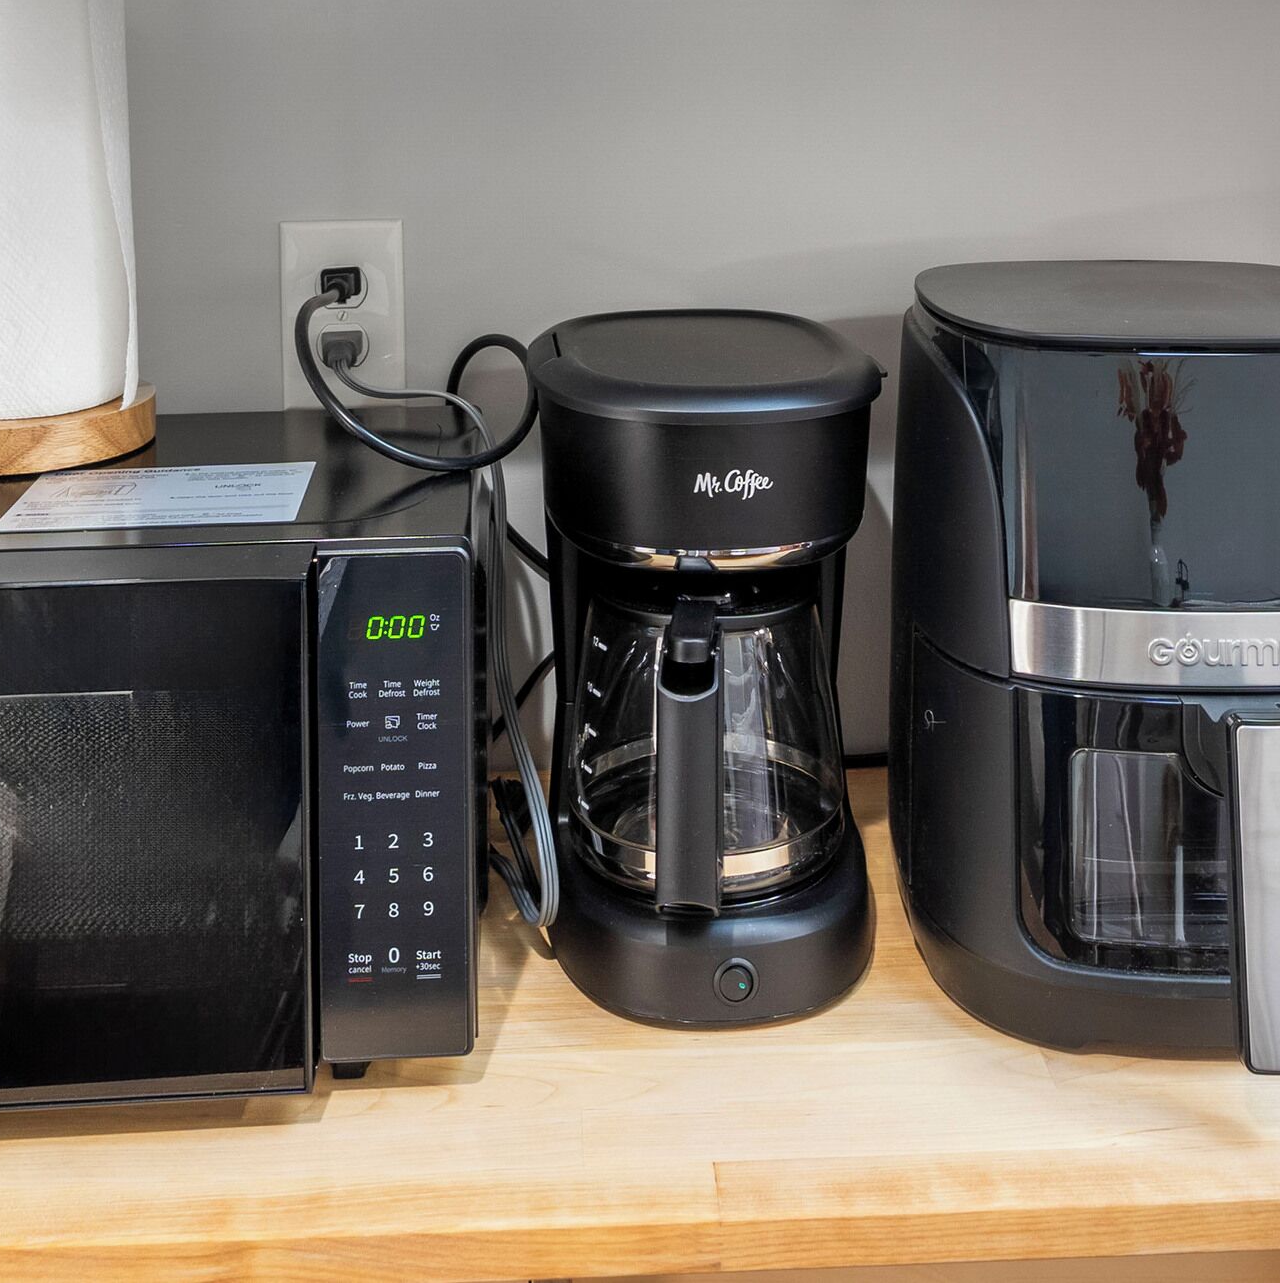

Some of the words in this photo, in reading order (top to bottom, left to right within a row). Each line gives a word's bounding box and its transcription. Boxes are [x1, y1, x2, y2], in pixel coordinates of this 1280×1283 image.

[693, 472, 722, 498] Mr.
[724, 469, 774, 500] Coffee
[429, 613, 440, 622] Oz
[365, 614, 426, 640] 0:00
[349, 681, 368, 690] Time
[383, 680, 402, 689] Time
[413, 679, 440, 689] Weight
[348, 690, 367, 699] Cook
[378, 689, 406, 698] Defrost
[413, 687, 441, 697] Defrost
[416, 712, 438, 721] Timer
[346, 719, 370, 729] Power
[417, 721, 437, 730] Clock
[378, 735, 408, 743] UNLOCK
[343, 764, 374, 774] Popcorn
[380, 762, 405, 771] Potato
[418, 761, 437, 771] Pizza
[343, 792, 357, 800] Frz.
[358, 791, 374, 801] Veg.
[375, 791, 410, 801] Beverage
[415, 789, 440, 799] Dinner
[354, 835, 364, 850] 1
[388, 834, 399, 849] 2
[423, 832, 434, 847] 3
[354, 869, 365, 885] 4
[388, 868, 400, 884] 5
[423, 866, 434, 882] 6
[354, 904, 365, 919] 7
[388, 902, 400, 918] 8
[423, 901, 434, 916] 9
[348, 953, 372, 964] Stop
[388, 947, 400, 964] 0
[416, 950, 441, 960] Start
[348, 965, 372, 974] cancel
[381, 965, 407, 974] Memory
[415, 962, 441, 971] +30sec
